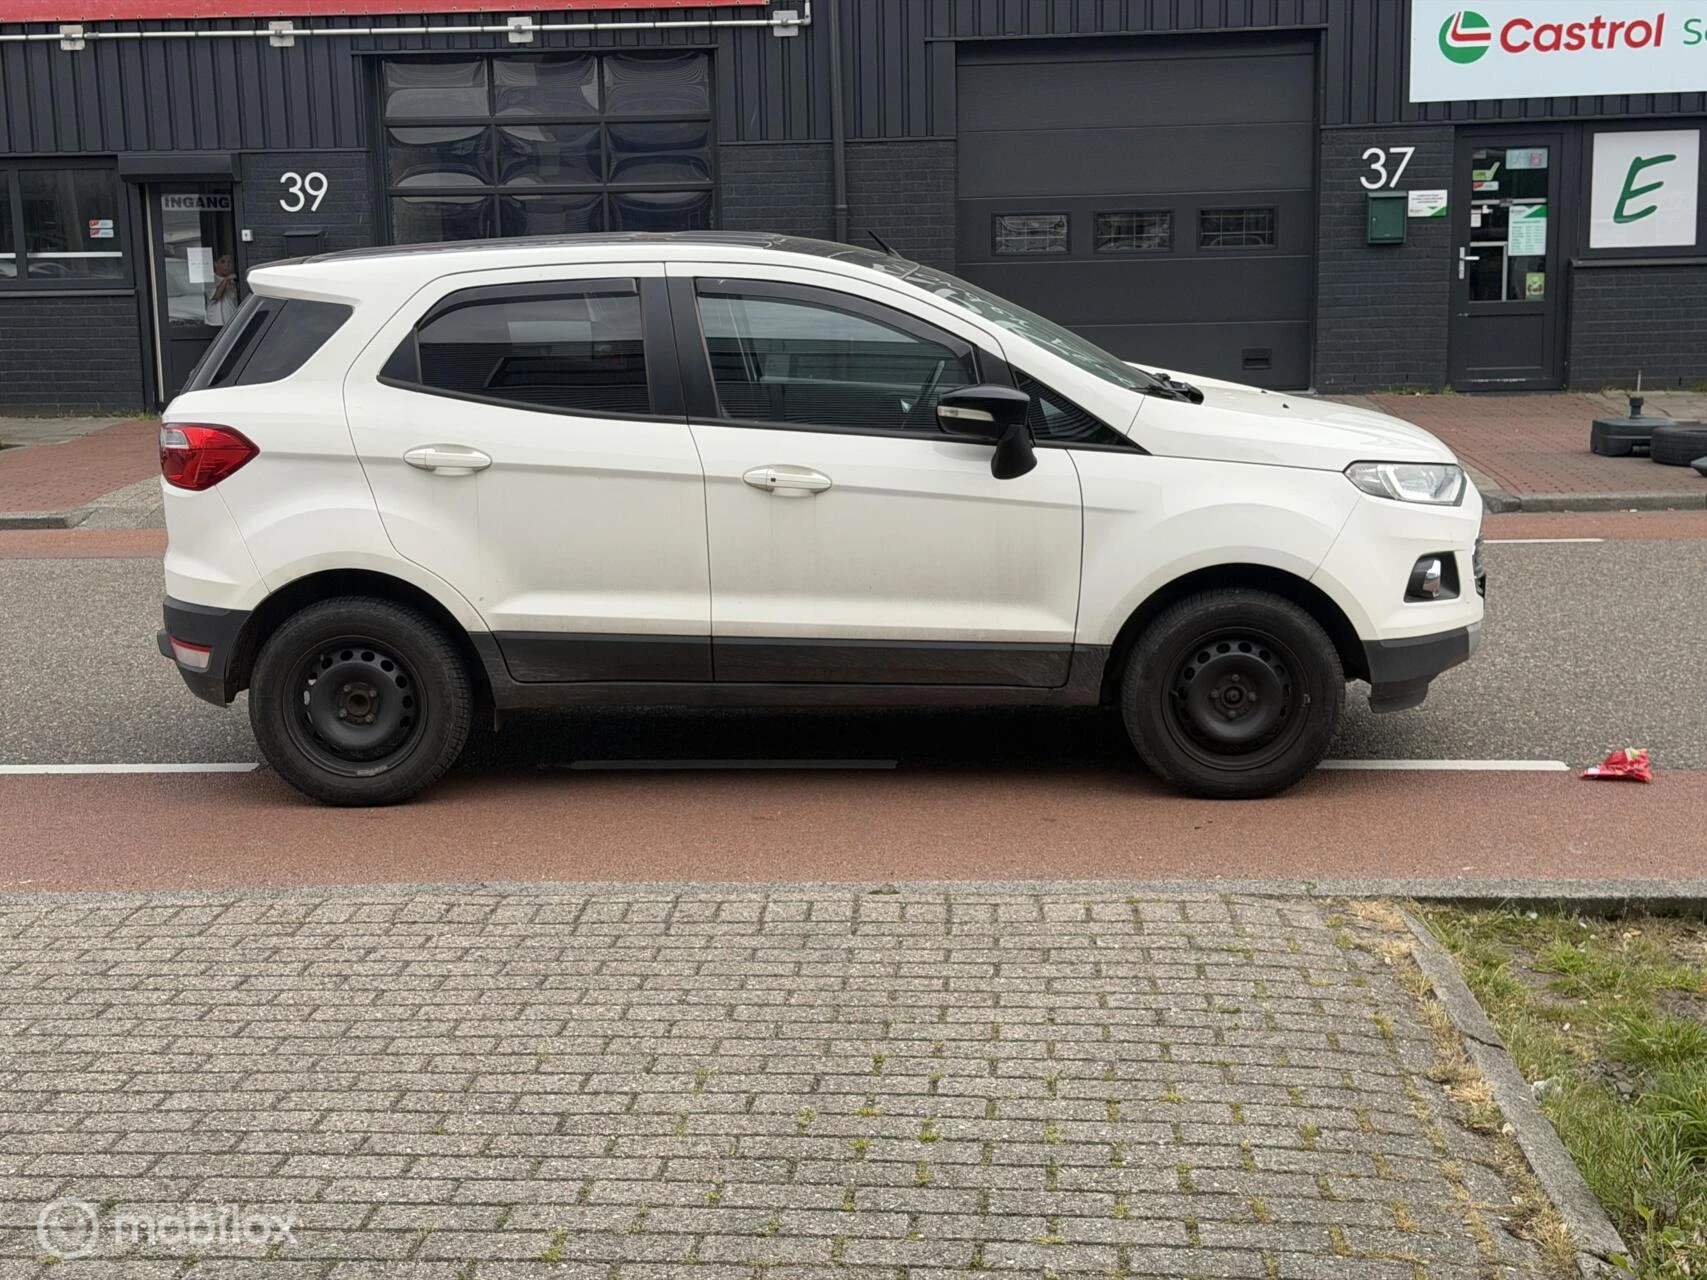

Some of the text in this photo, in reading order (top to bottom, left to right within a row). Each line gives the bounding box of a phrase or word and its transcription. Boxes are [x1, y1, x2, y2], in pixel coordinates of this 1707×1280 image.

[1500, 13, 1707, 53] Castrol S
[1360, 147, 1416, 190] 37
[164, 196, 231, 209] INGANG
[279, 172, 328, 212] 39
[1613, 154, 1677, 224] E
